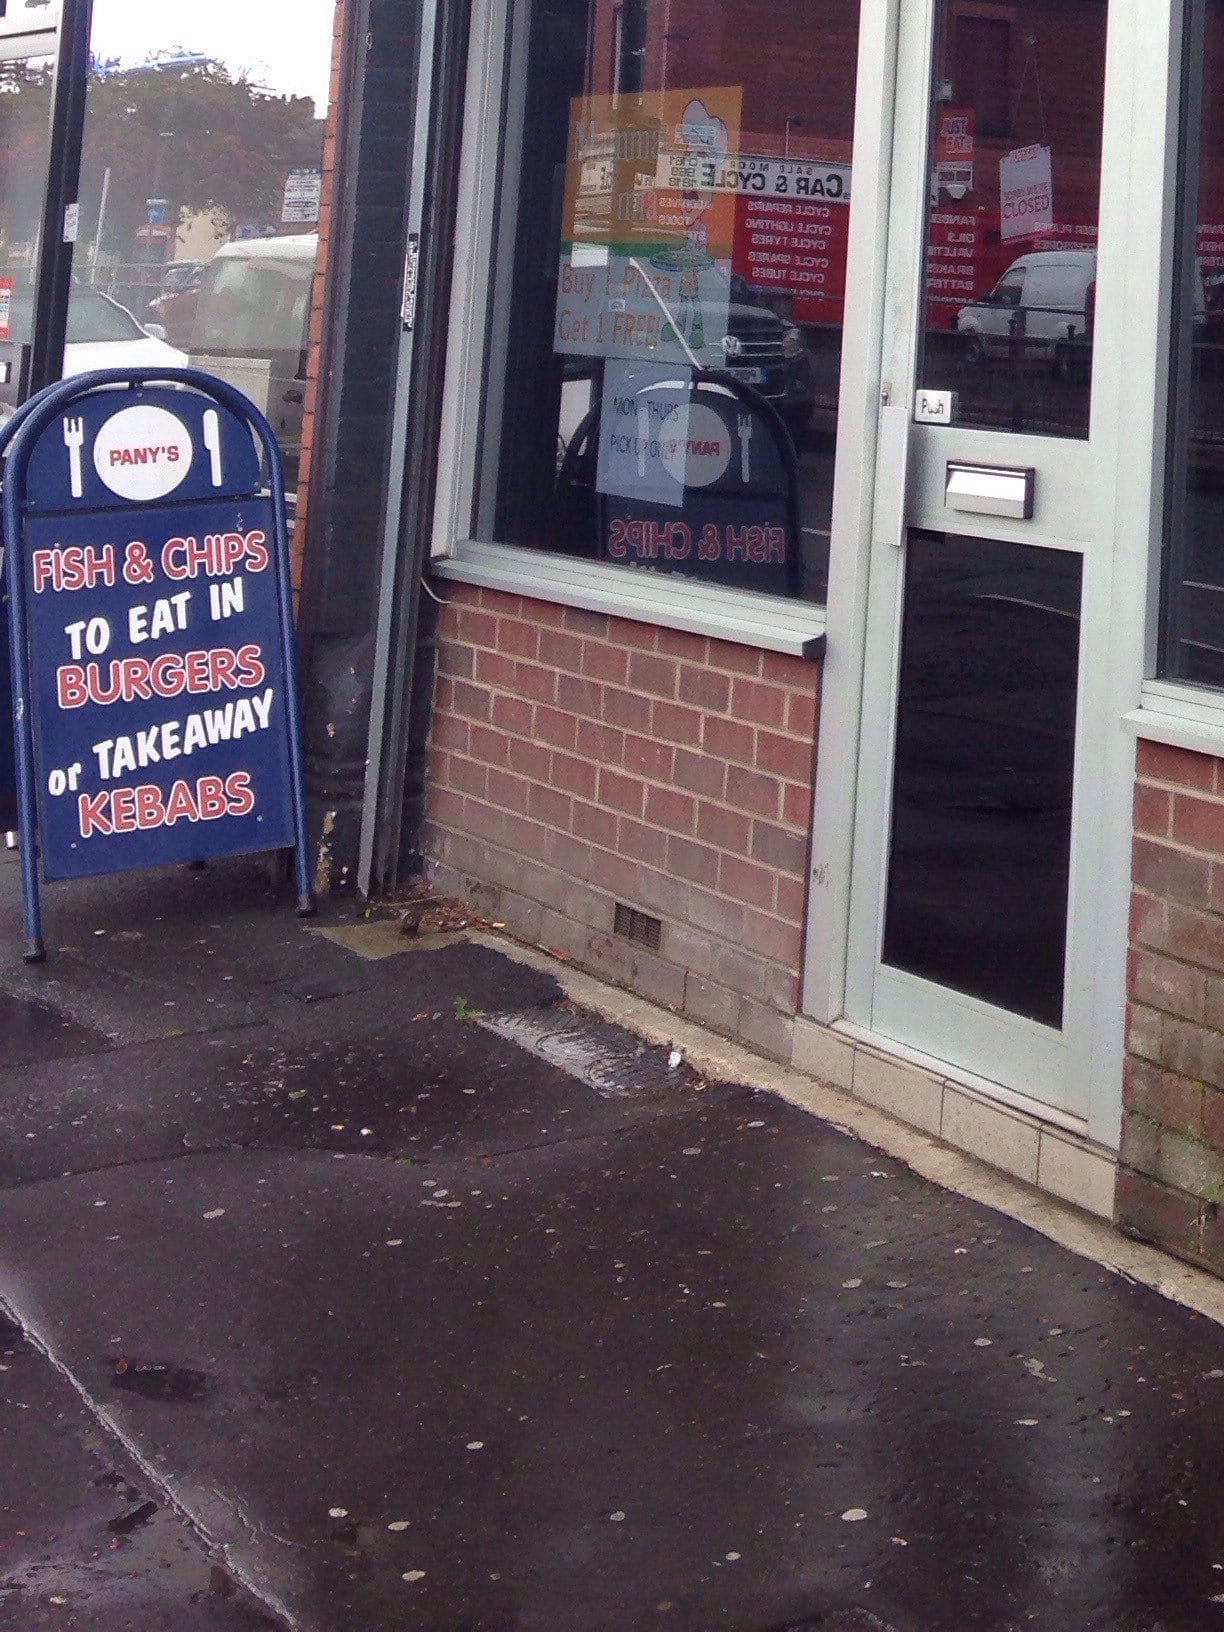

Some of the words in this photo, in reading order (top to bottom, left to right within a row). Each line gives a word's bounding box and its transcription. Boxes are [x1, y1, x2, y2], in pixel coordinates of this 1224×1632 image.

[1002, 195, 1049, 218] CLOSED
[562, 262, 596, 303] Buy
[559, 307, 590, 342] Get
[109, 445, 180, 467] PANY'S
[33, 542, 115, 593] FISH
[123, 541, 154, 584] &
[161, 530, 269, 581] CHIPS
[65, 618, 110, 660] TO
[128, 591, 193, 645] EAT
[209, 576, 245, 623] IN
[56, 644, 266, 709] BURGERS
[48, 762, 82, 796] or
[92, 688, 274, 779] TAKEAWAY
[78, 770, 256, 838] KEBABS
